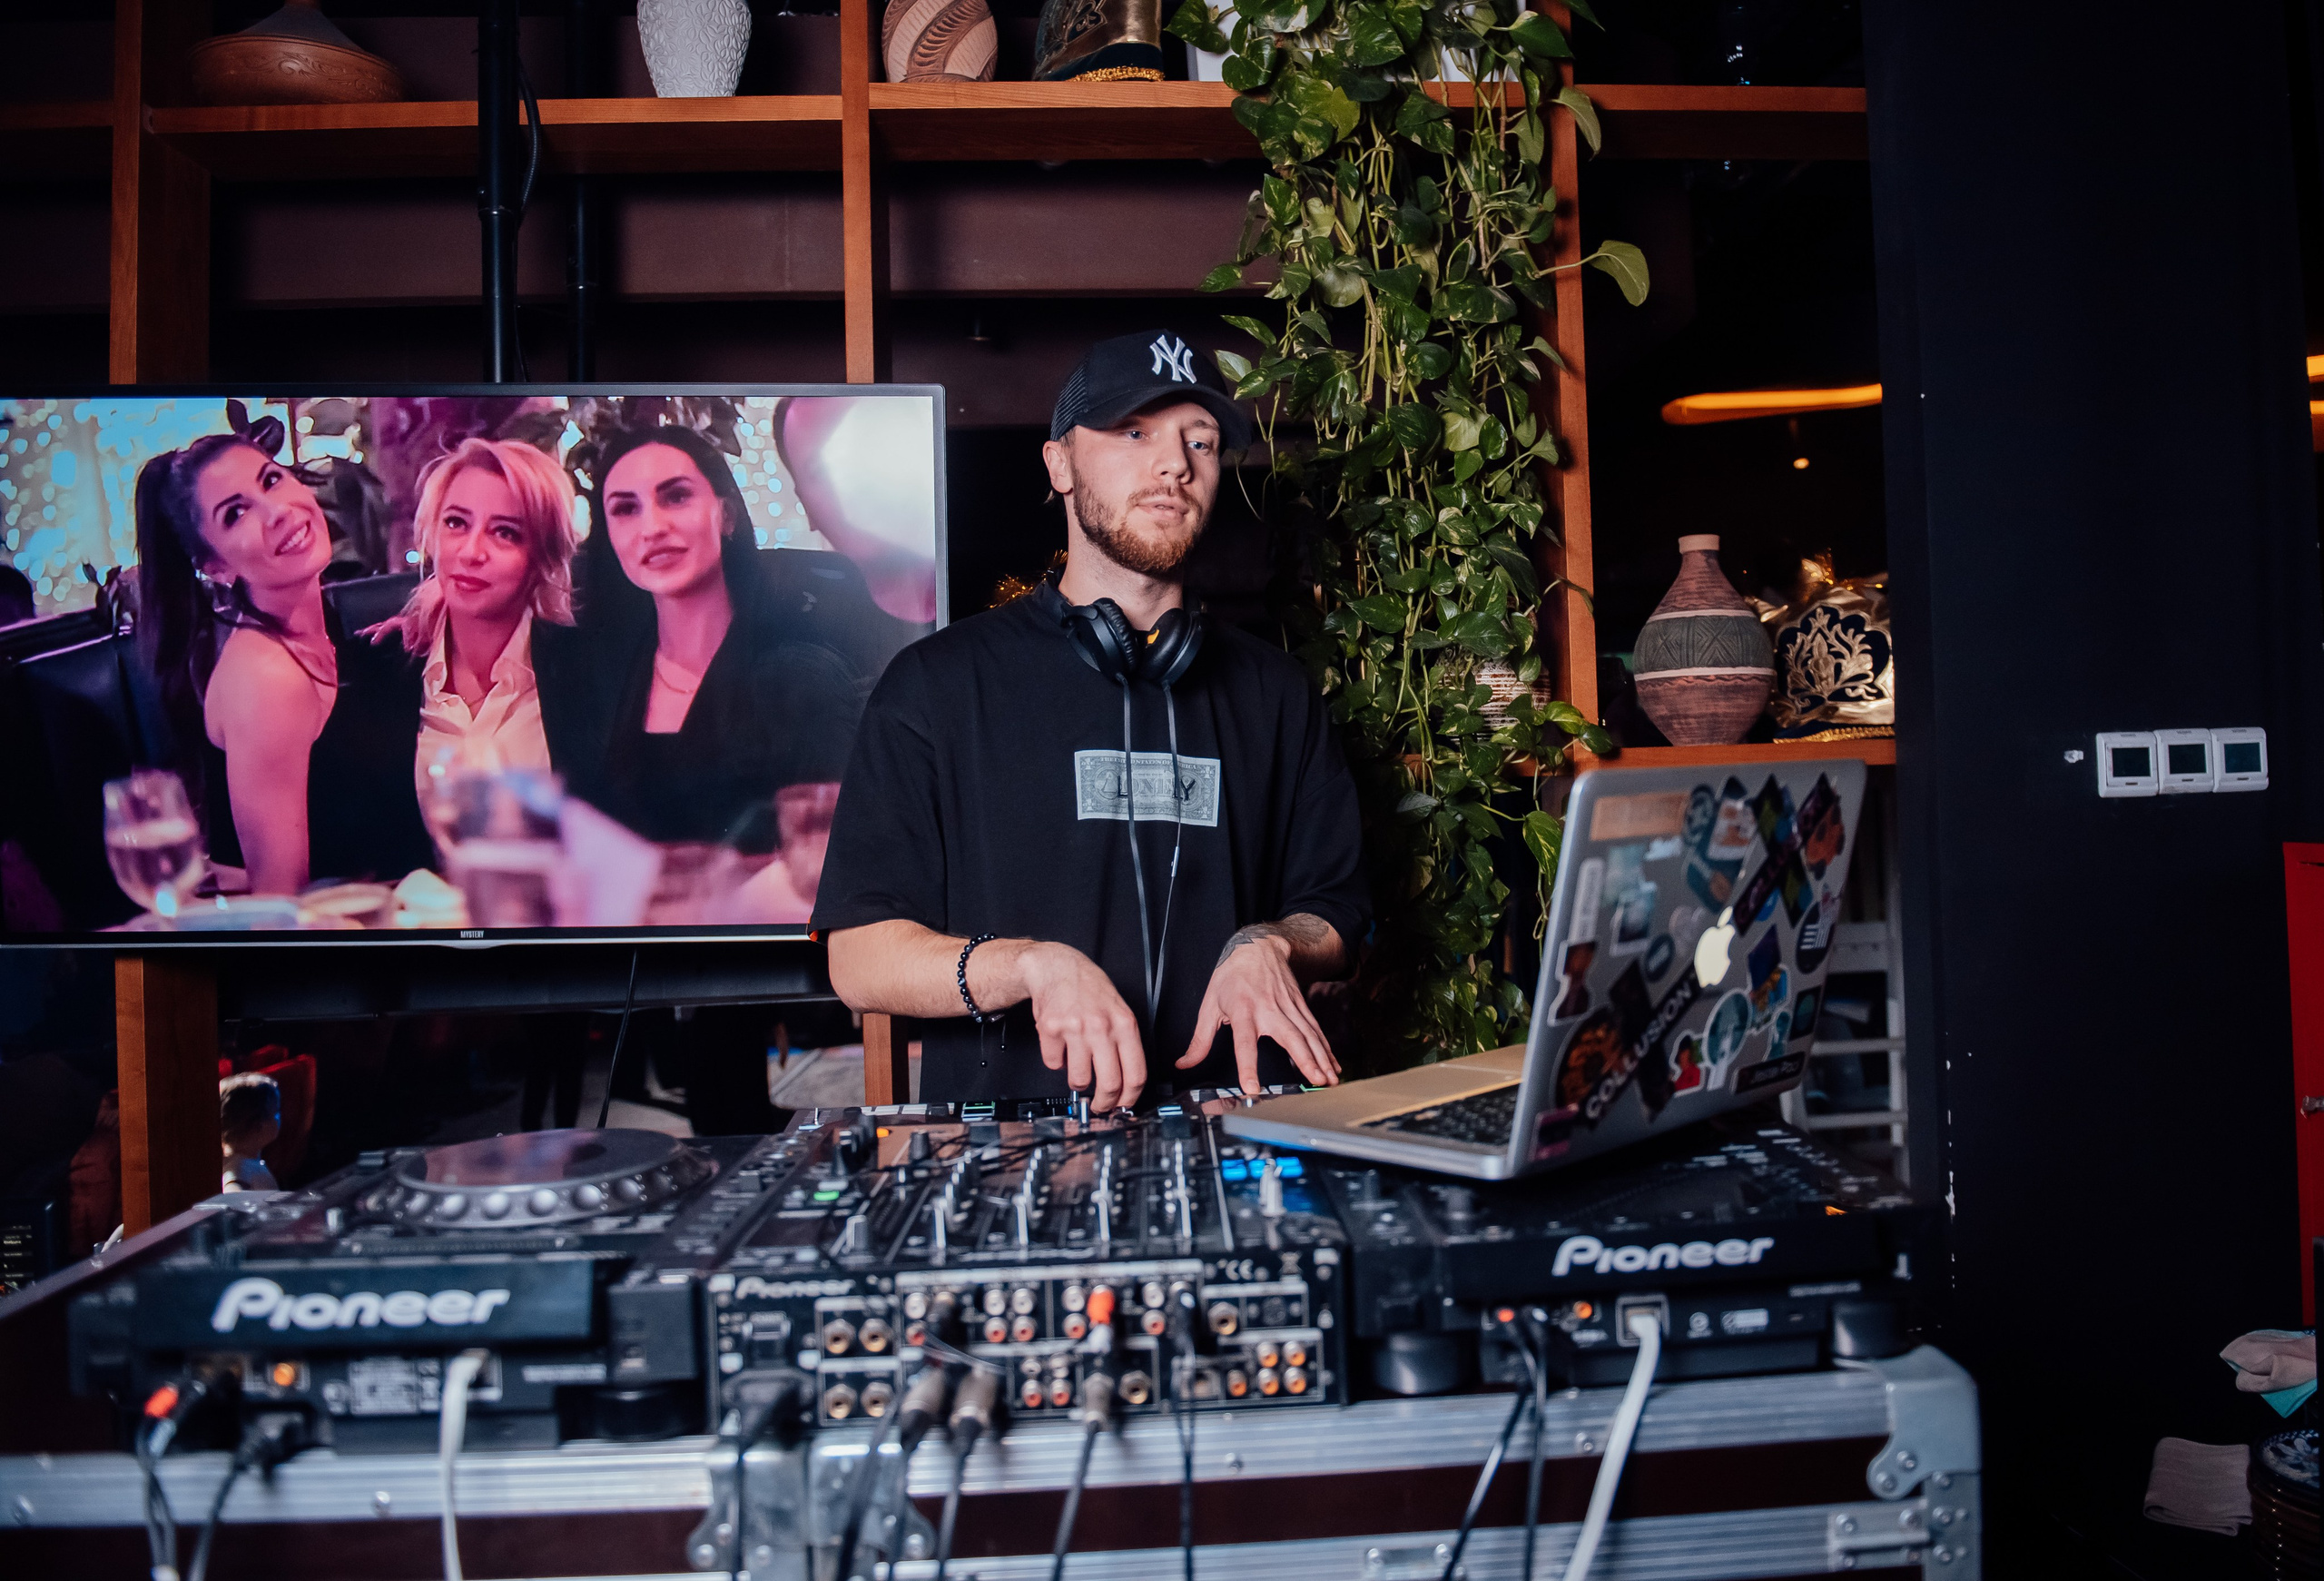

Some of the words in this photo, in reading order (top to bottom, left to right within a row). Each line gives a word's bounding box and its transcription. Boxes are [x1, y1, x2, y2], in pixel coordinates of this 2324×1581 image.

[1149, 334, 1197, 384] NY
[460, 930, 484, 938] MYSTERY
[1551, 1235, 1775, 1276] Pioneer
[212, 1278, 510, 1332] Pioneer
